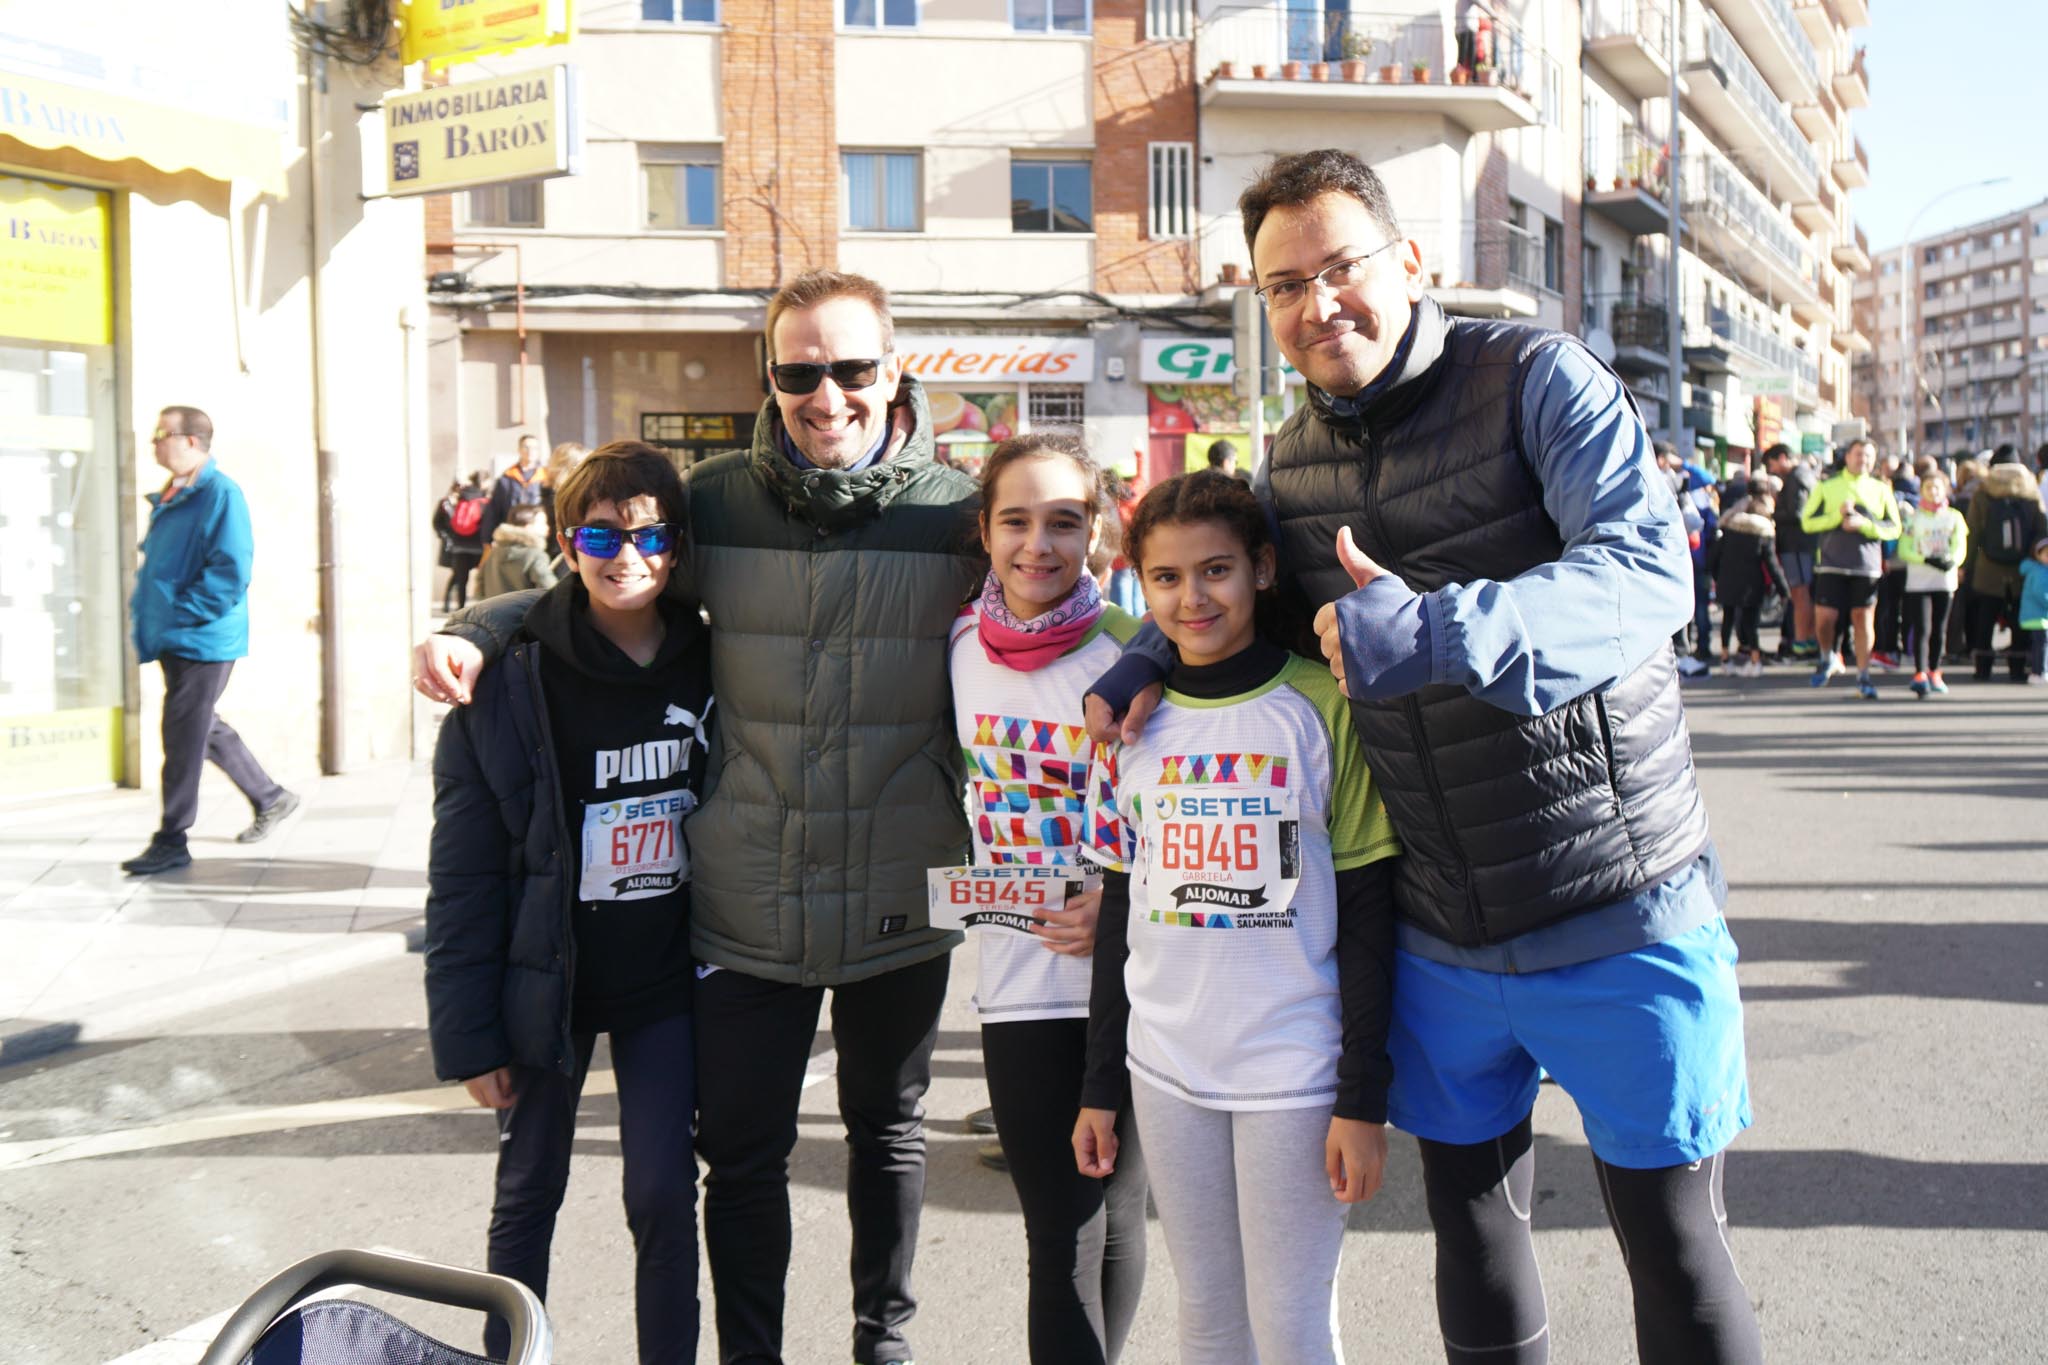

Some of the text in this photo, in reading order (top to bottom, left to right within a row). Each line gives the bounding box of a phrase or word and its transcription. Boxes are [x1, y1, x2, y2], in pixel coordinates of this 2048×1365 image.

[392, 79, 547, 128] INMOBILIARIA
[444, 115, 549, 159] BARÓN
[1157, 343, 1233, 379] Gr
[595, 736, 694, 789] PUMA
[624, 797, 688, 820] SETEL
[1181, 797, 1282, 817] SETEL
[611, 819, 674, 866] 6771
[1162, 823, 1258, 871] 6946
[626, 876, 673, 889] ALJOMAR
[970, 867, 1070, 878] SETEL
[1182, 871, 1234, 882] GABRIELA
[950, 880, 1045, 905] 6945
[1185, 887, 1252, 905] ALJOMAR
[1236, 919, 1294, 928] SALMANTINA
